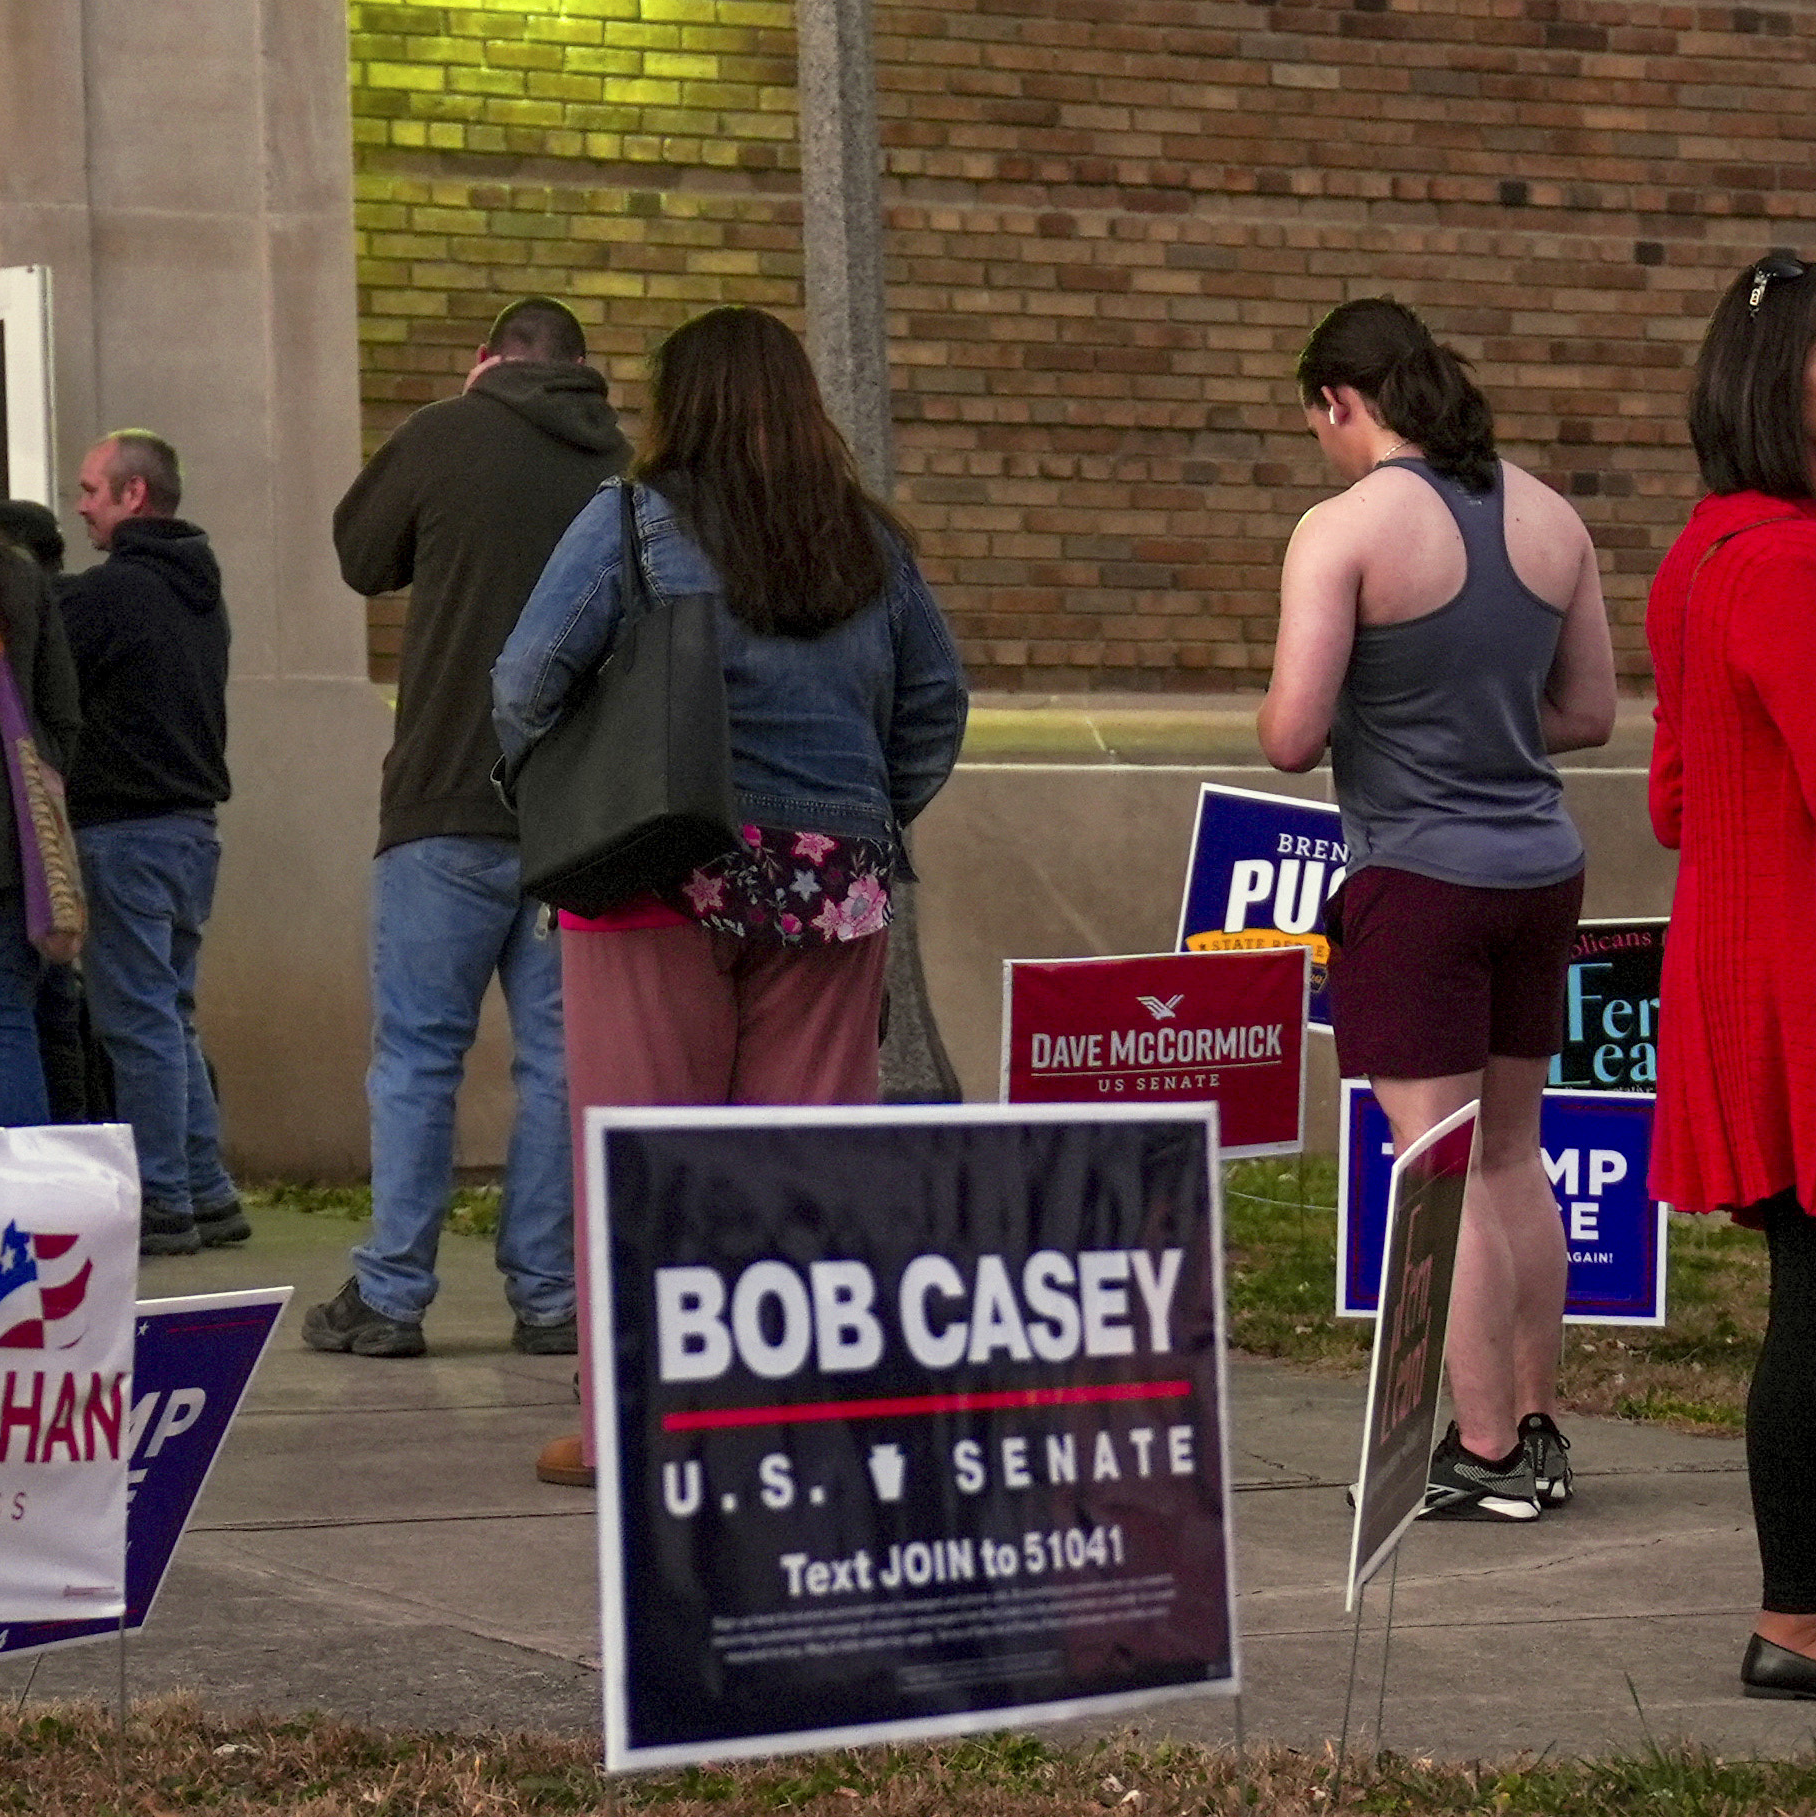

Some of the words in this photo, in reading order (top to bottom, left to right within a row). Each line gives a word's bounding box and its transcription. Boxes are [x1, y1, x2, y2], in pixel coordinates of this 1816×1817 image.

[1277, 833, 1349, 863] BREN
[1223, 859, 1346, 935] PU
[1568, 963, 1661, 1042] Fer
[1031, 1032, 1103, 1069] DAVE
[1098, 1078, 1125, 1092] US
[1136, 1073, 1220, 1091] SENATE
[653, 1259, 883, 1382] BOB
[898, 1248, 1185, 1368] CASEY
[663, 1454, 825, 1516] U.S.
[953, 1424, 1195, 1493] SENATE
[781, 1551, 873, 1596] Text
[882, 1538, 973, 1587] JOIN
[982, 1540, 1018, 1577] to
[1024, 1526, 1125, 1571] 51041
